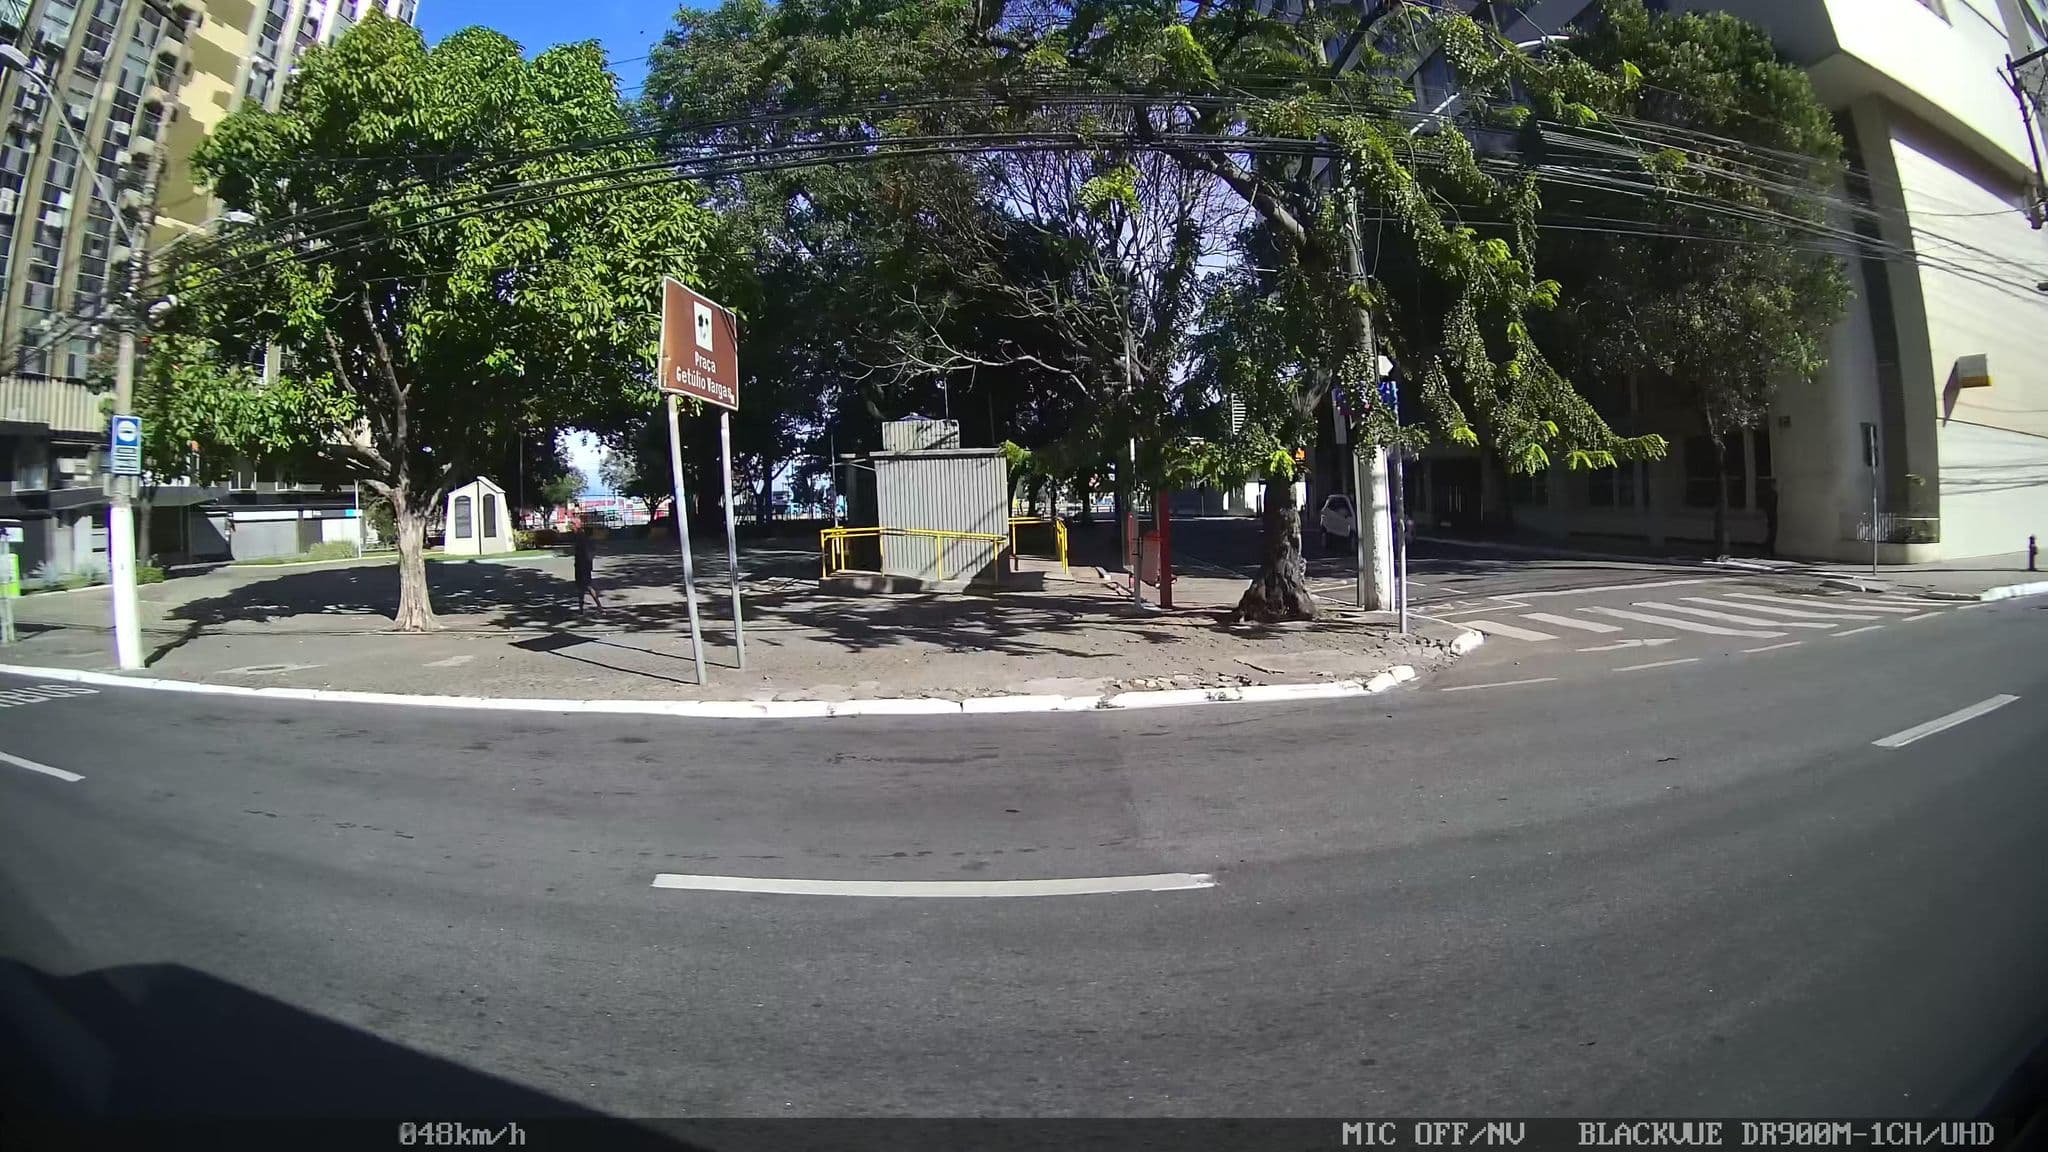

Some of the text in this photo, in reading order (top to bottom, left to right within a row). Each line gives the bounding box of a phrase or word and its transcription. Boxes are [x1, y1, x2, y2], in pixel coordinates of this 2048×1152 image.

[694, 350, 717, 374] Praça
[676, 366, 732, 400] Getúlio Vargas
